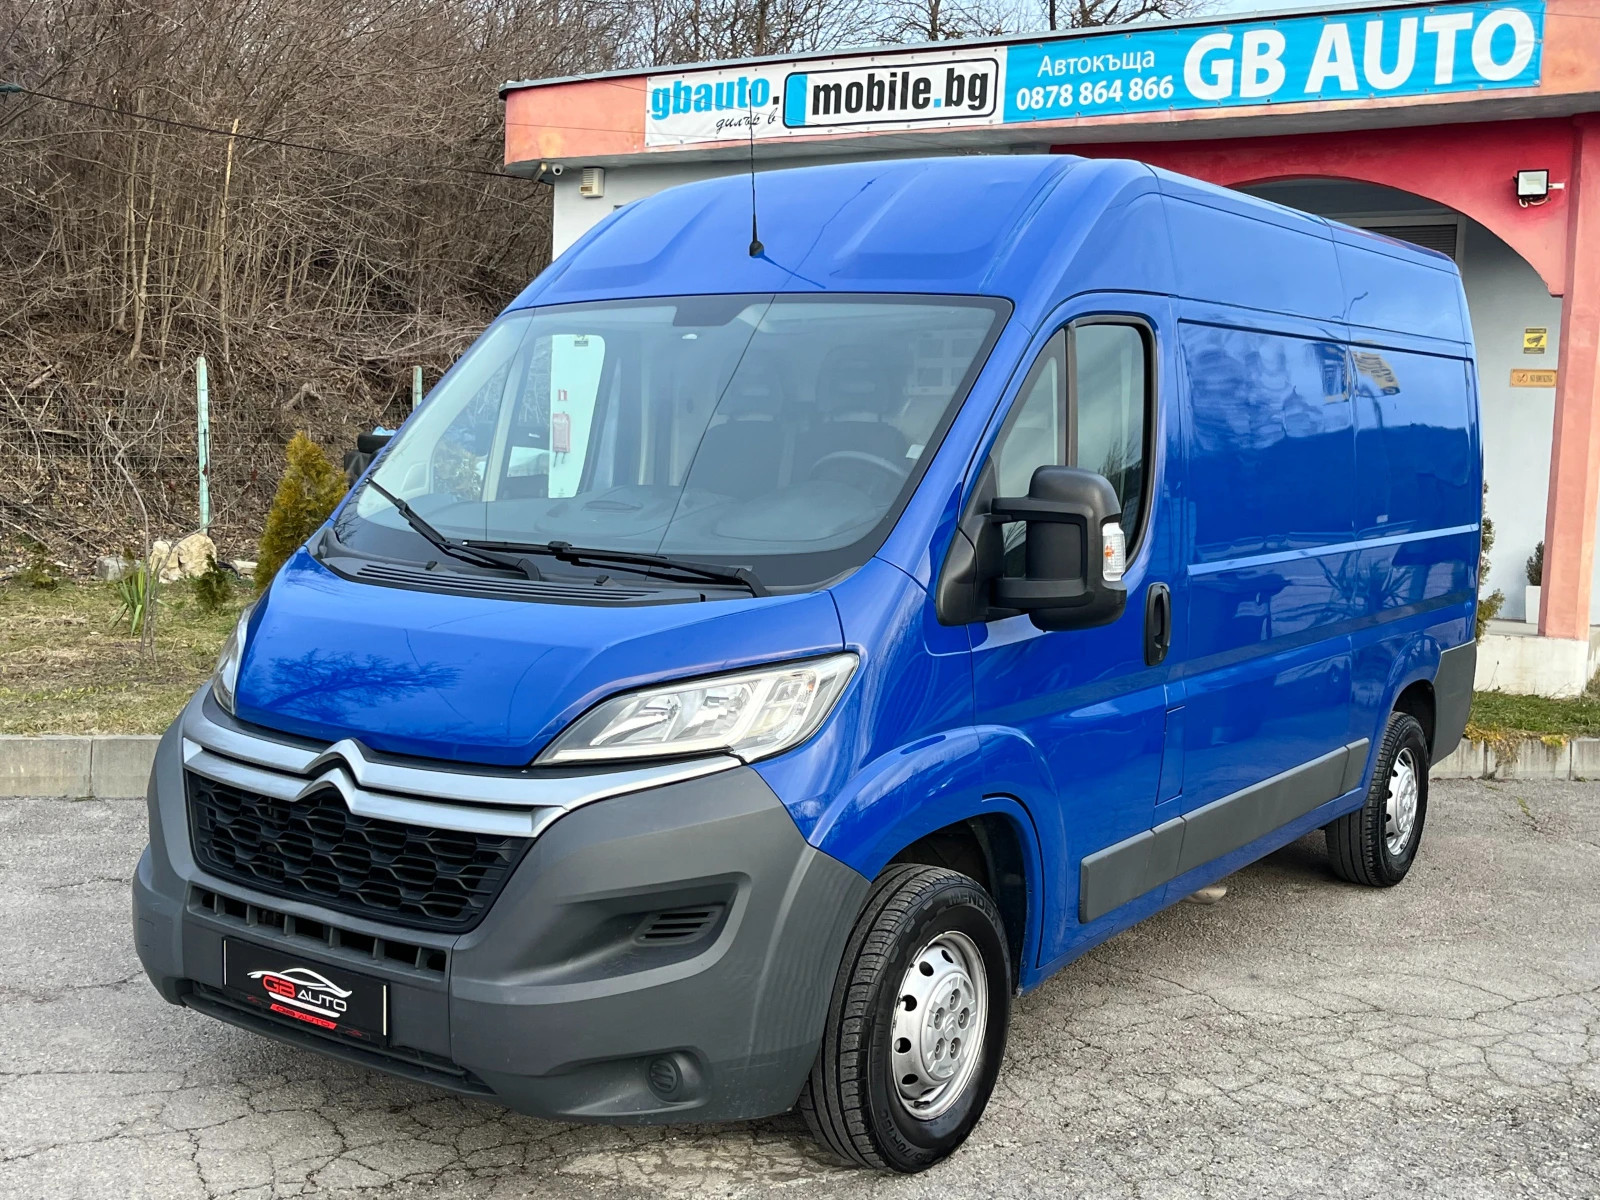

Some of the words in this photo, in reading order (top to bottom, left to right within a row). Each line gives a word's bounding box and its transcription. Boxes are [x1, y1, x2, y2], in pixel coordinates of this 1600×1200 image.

[1037, 48, 1155, 78] Автокъща
[1183, 29, 1286, 100] GB
[1303, 7, 1535, 93] AUTO
[812, 67, 989, 116] mobile.bg
[1016, 83, 1073, 111] 0878
[1078, 80, 1123, 106] 864
[1128, 75, 1174, 102] 866
[263, 975, 295, 998] GB
[298, 990, 346, 1012] AUTO
